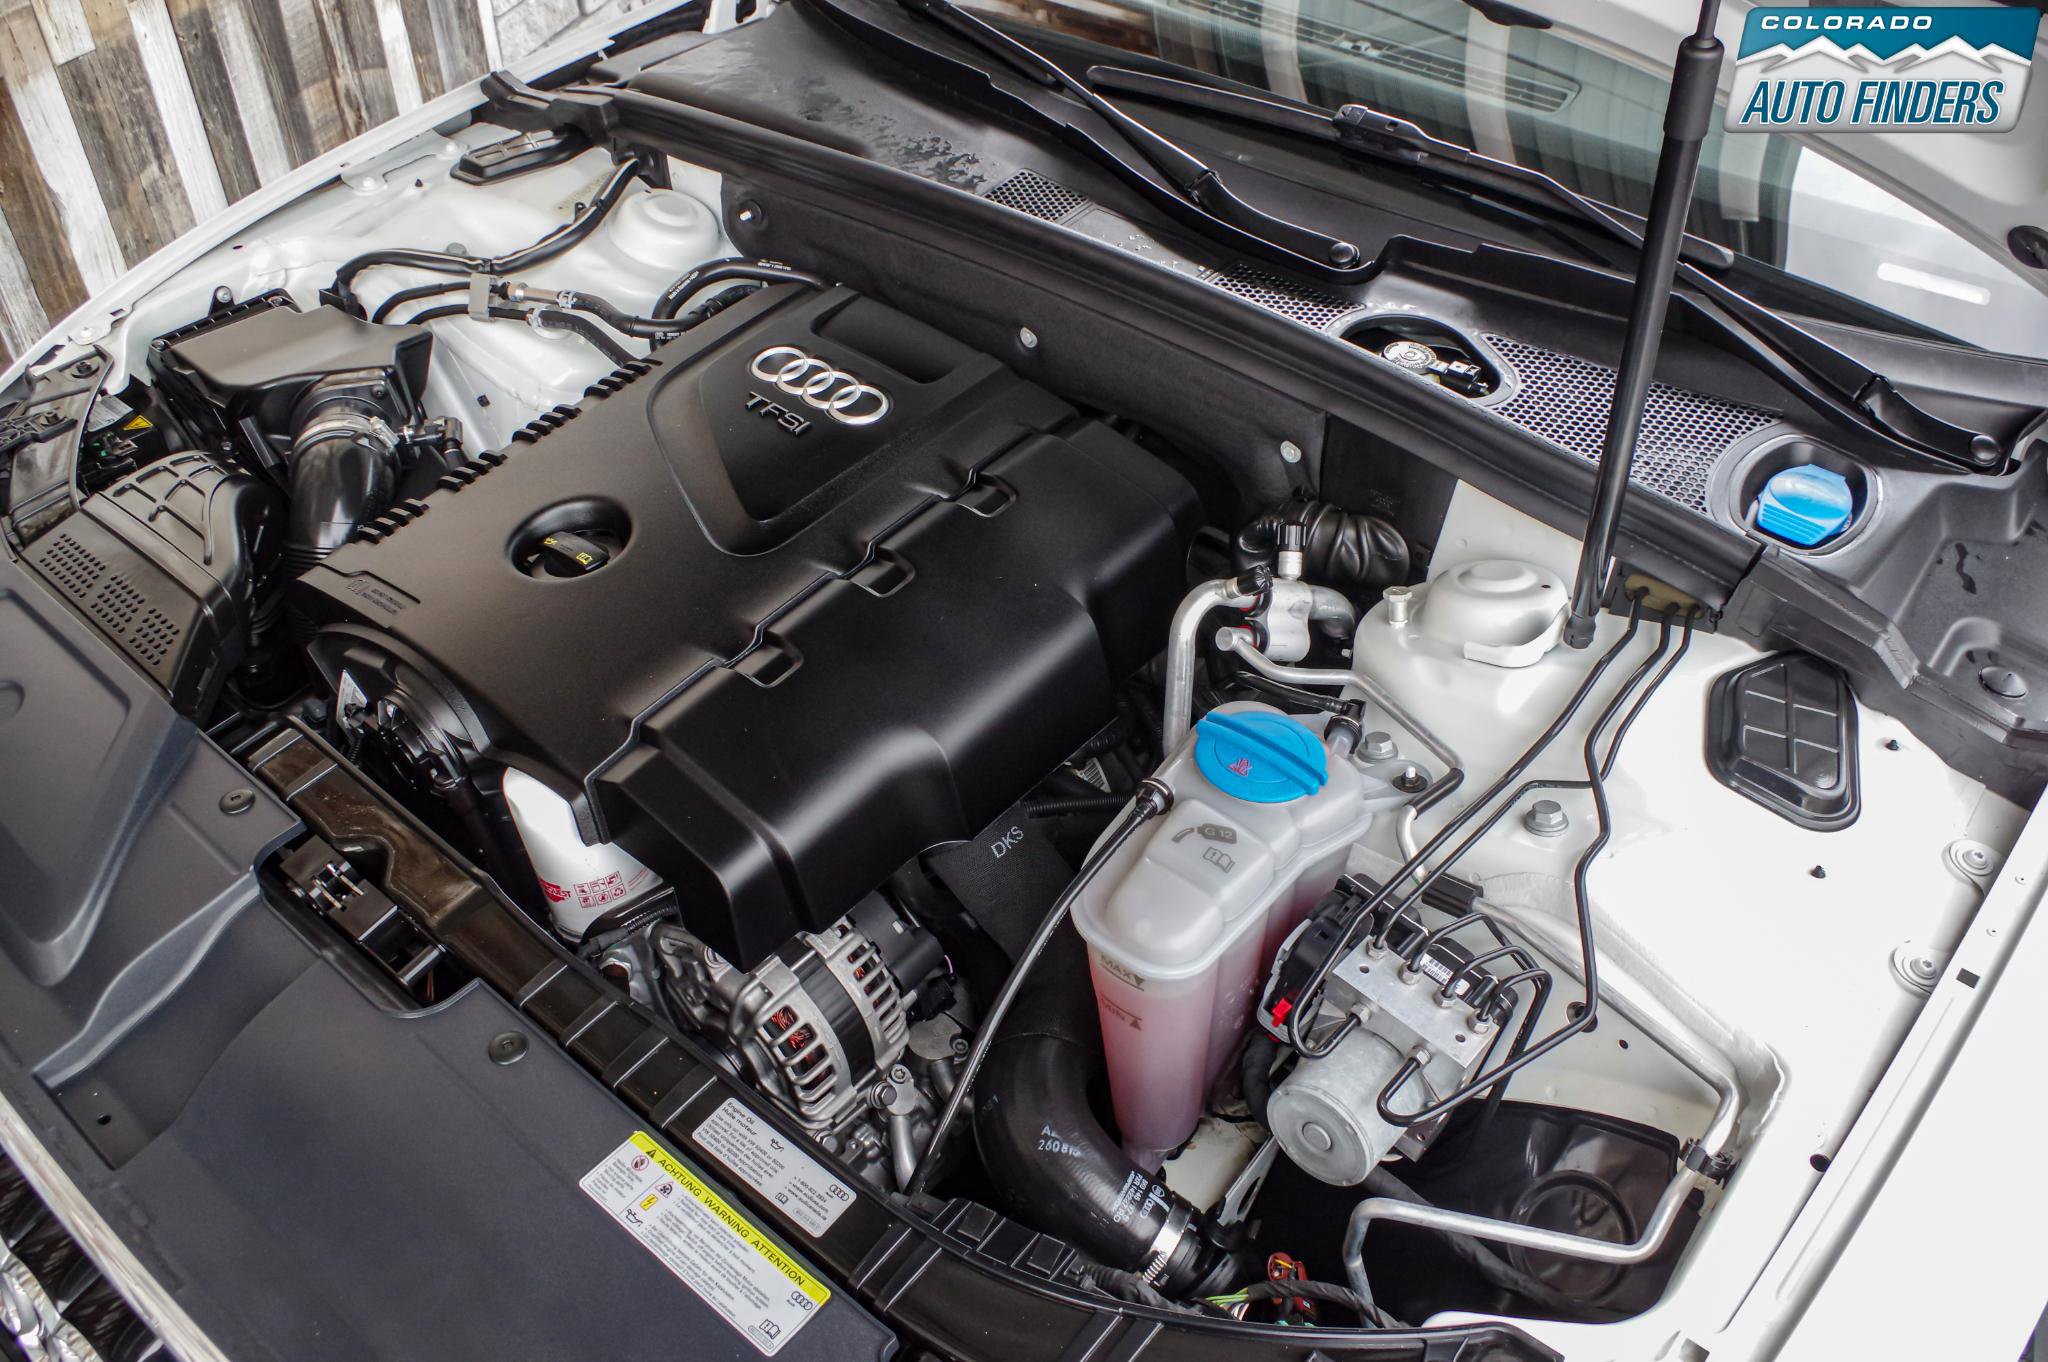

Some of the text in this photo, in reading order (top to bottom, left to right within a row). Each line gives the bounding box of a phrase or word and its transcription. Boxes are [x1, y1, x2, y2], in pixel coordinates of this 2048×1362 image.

[745, 391, 812, 436] TFSI
[990, 826, 1024, 858] DKS
[721, 1106, 758, 1136] Huile moteur
[726, 1102, 755, 1125] Engine Oil
[656, 1157, 703, 1197] ACHTUNG
[701, 1196, 751, 1238] WARNING
[749, 1237, 807, 1286] ATTENTION
